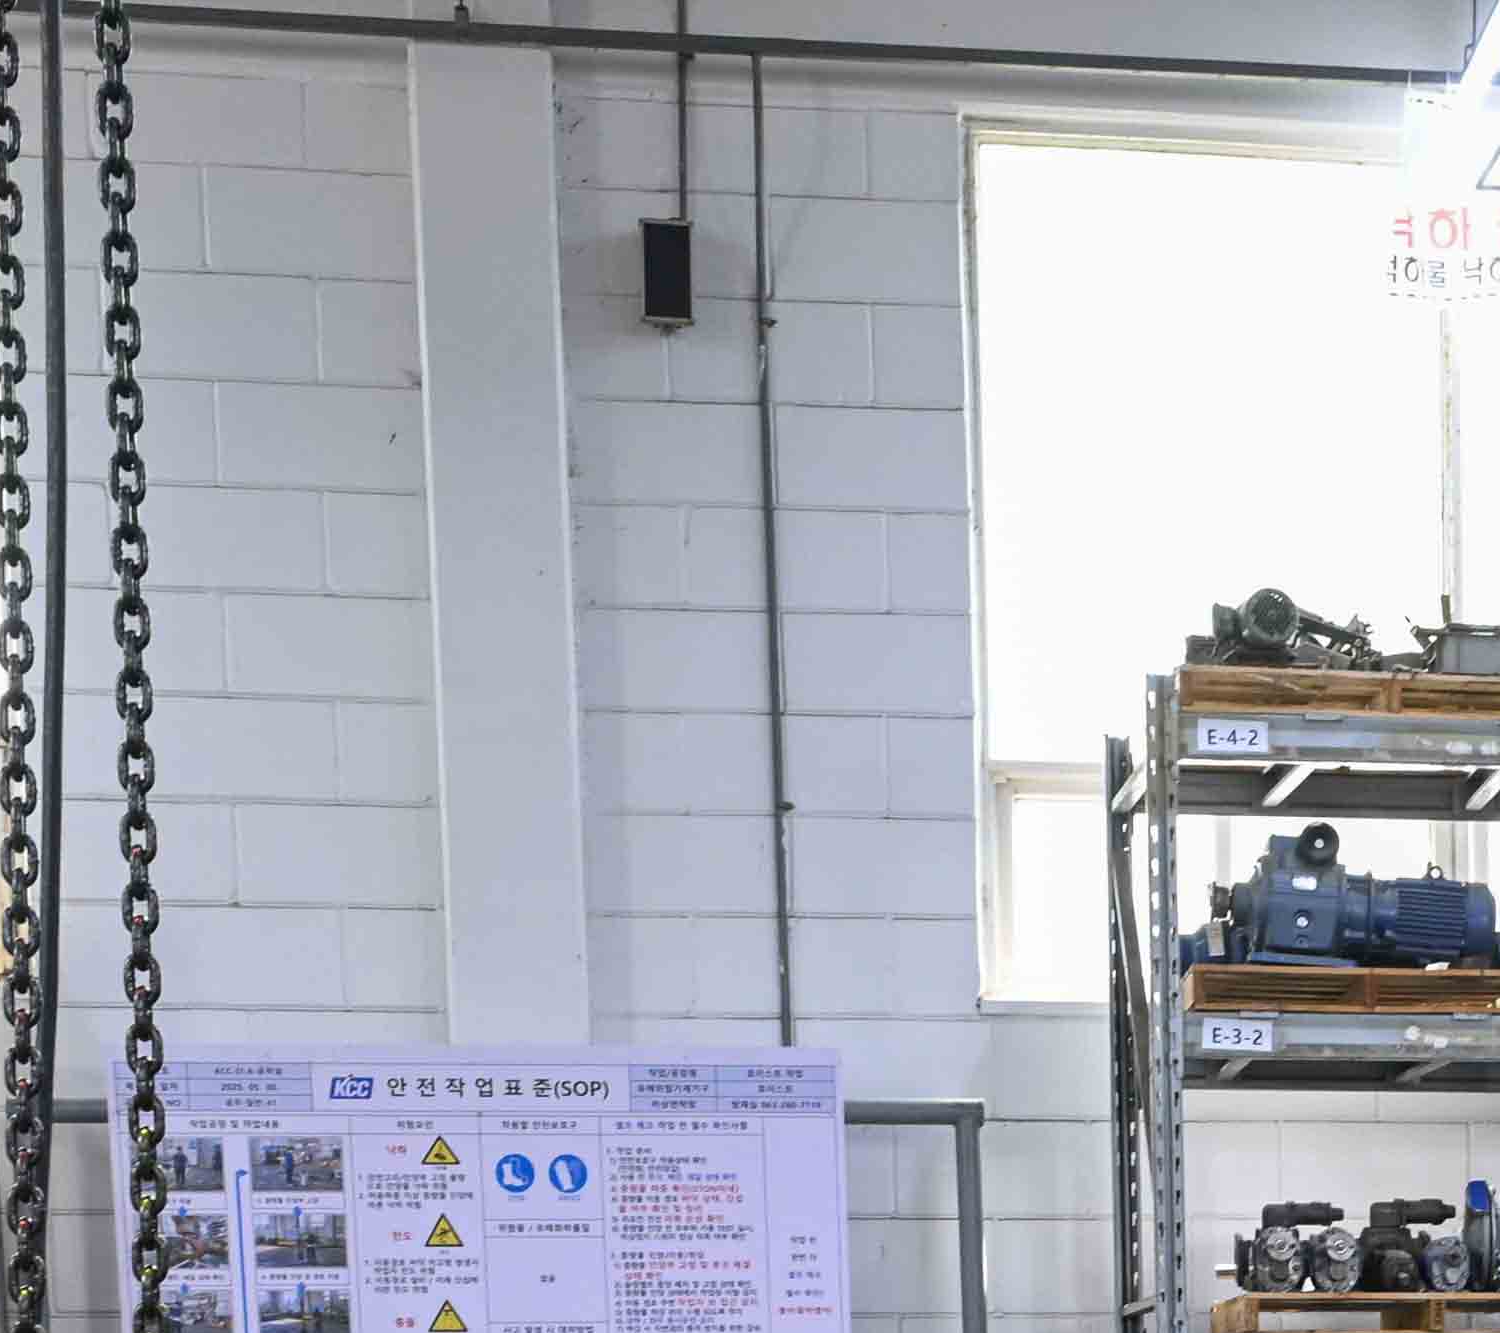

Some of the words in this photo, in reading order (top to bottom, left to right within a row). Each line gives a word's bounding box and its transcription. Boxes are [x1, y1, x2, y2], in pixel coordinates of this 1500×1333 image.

[1207, 728, 1258, 748] E-4-2
[1211, 1027, 1263, 1046] E-3-2
[330, 1077, 373, 1099] KCC
